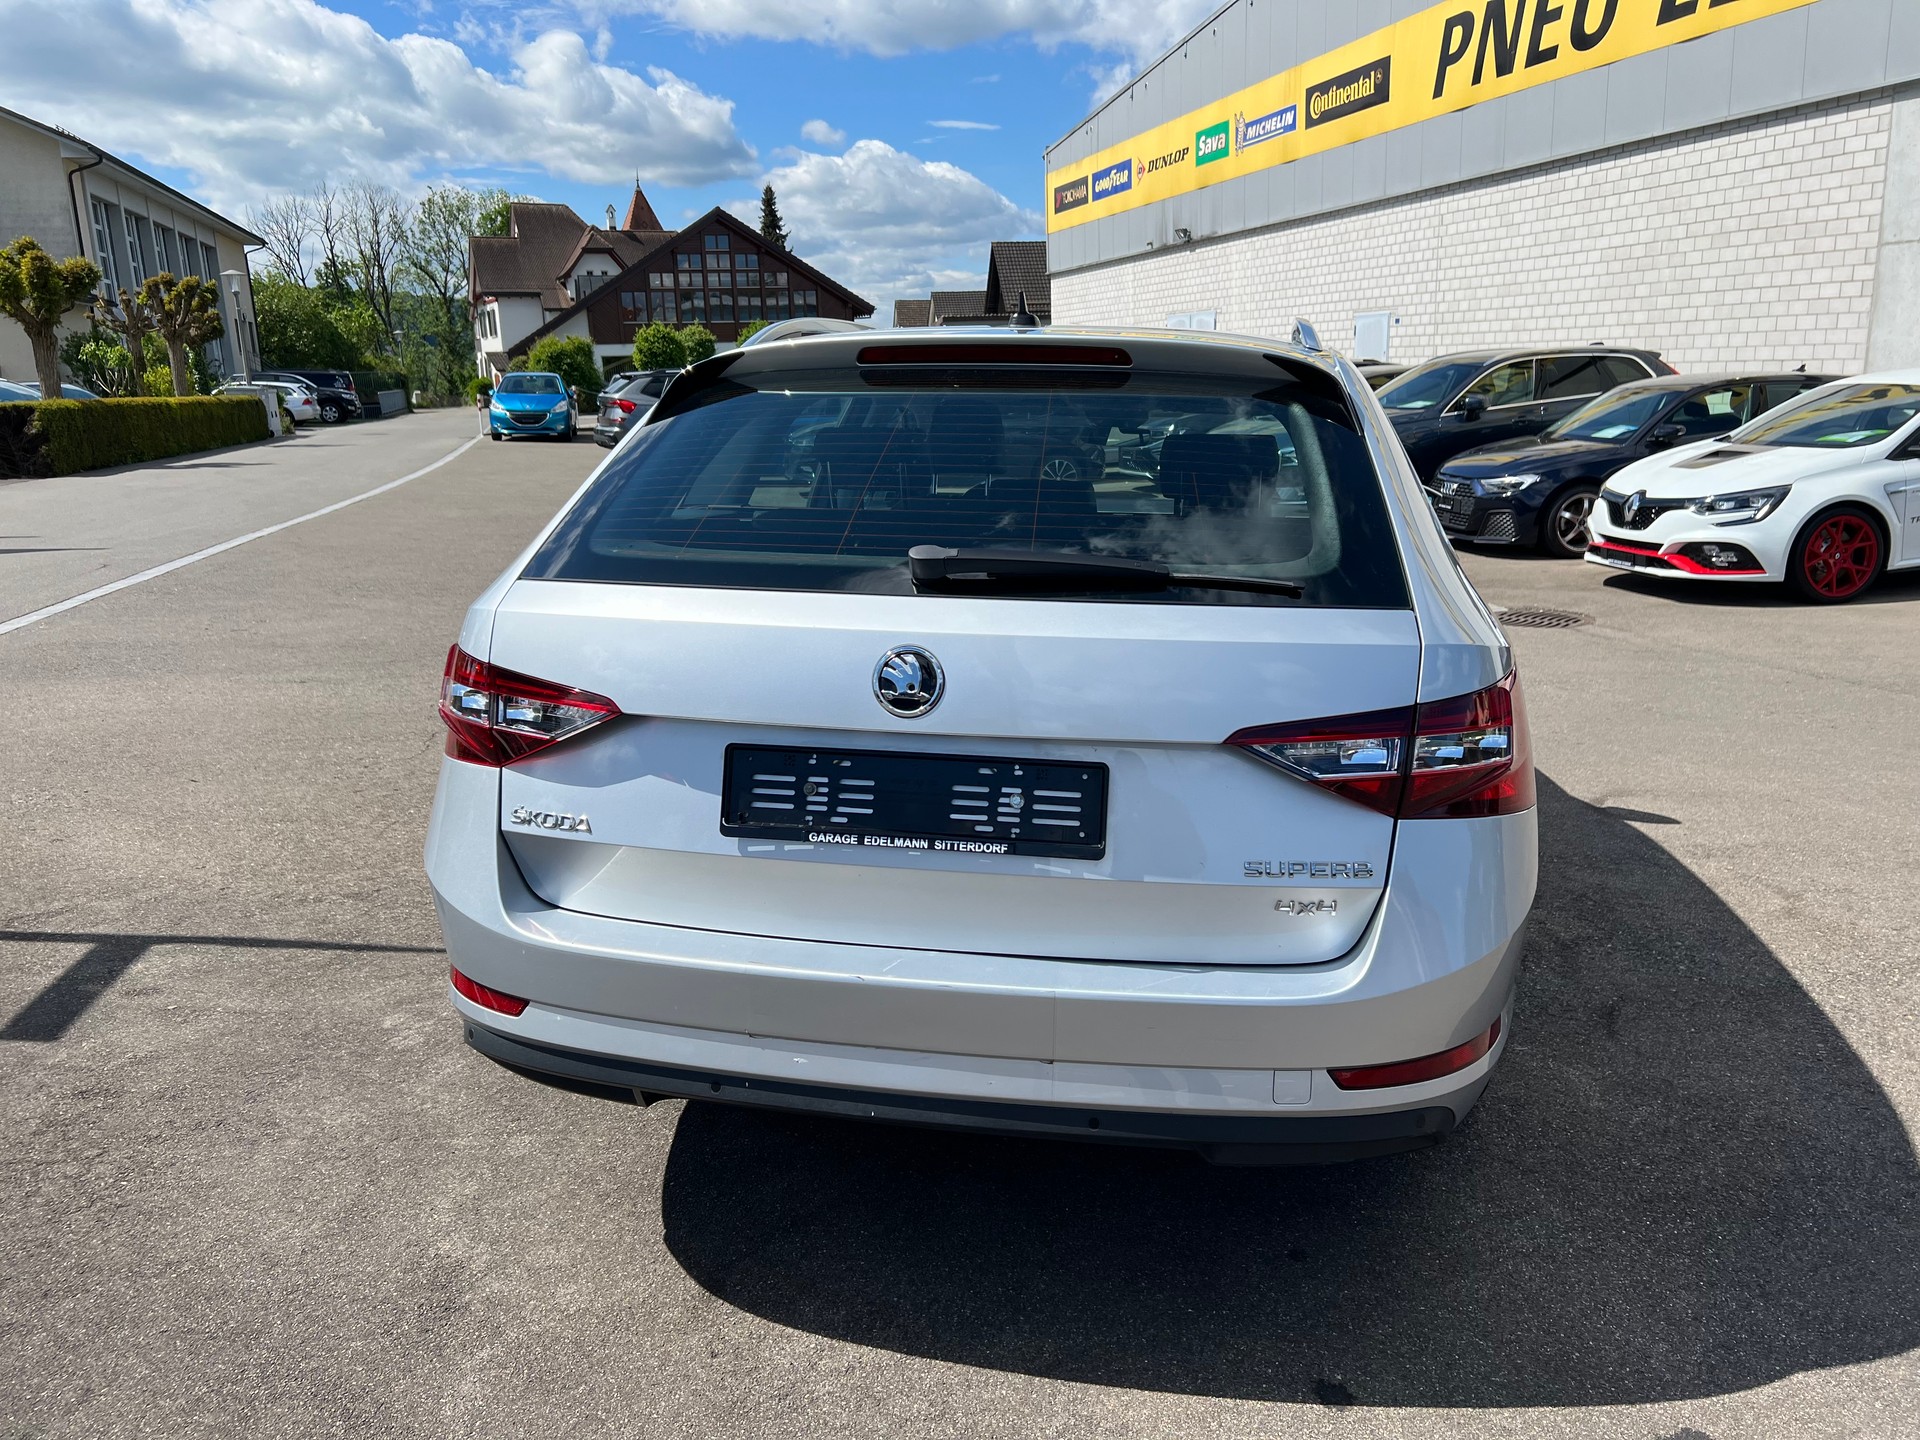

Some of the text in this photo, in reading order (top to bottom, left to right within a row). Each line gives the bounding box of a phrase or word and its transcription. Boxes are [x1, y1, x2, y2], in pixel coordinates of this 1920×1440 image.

[1432, 0, 1618, 100] PNEU
[1310, 70, 1375, 119] Continental
[1246, 110, 1295, 140] MICHELIN
[1198, 133, 1226, 157] Sava
[1147, 147, 1189, 173] DUNLOP
[1095, 169, 1129, 193] GOODYEAR
[808, 832, 1009, 854] GARAGE EDELMANN SITTERDORF
[1243, 861, 1374, 879] SUPERB
